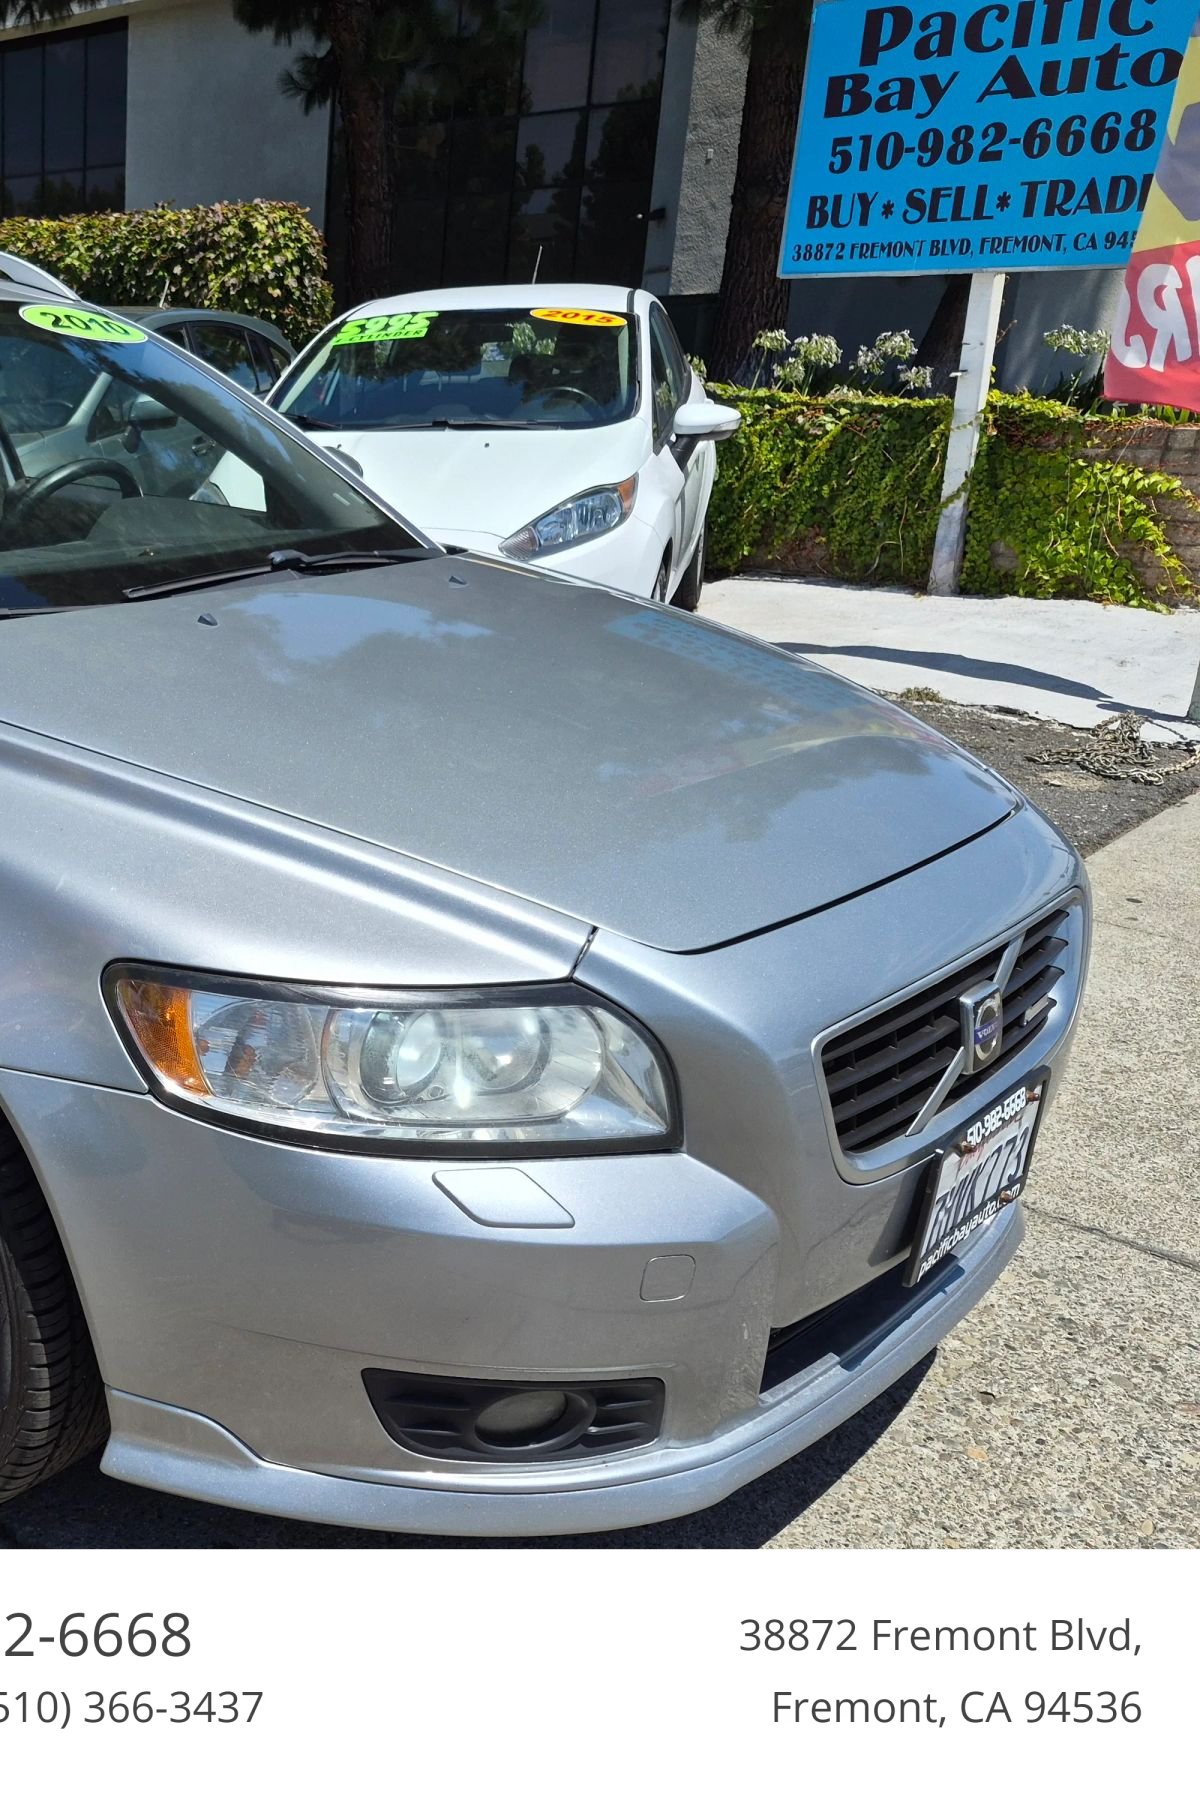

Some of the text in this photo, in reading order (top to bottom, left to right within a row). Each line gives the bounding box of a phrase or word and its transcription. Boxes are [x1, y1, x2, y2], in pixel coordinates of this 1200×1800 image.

[859, 0, 1156, 67] Pacific
[823, 43, 1184, 119] Bay Auto
[828, 108, 1158, 175] 510-982-6668
[792, 243, 846, 262] 38872
[850, 239, 928, 260] FREMONT
[929, 235, 974, 257] BLVD,
[979, 233, 1067, 255] FREMONT,
[1073, 232, 1098, 250] CA
[39, 311, 132, 337] 2010
[336, 311, 440, 338] 5995
[541, 310, 617, 324] 2015
[966, 1086, 1027, 1147] 510-982-6668
[917, 1183, 1021, 1282] pacificbayauto.m
